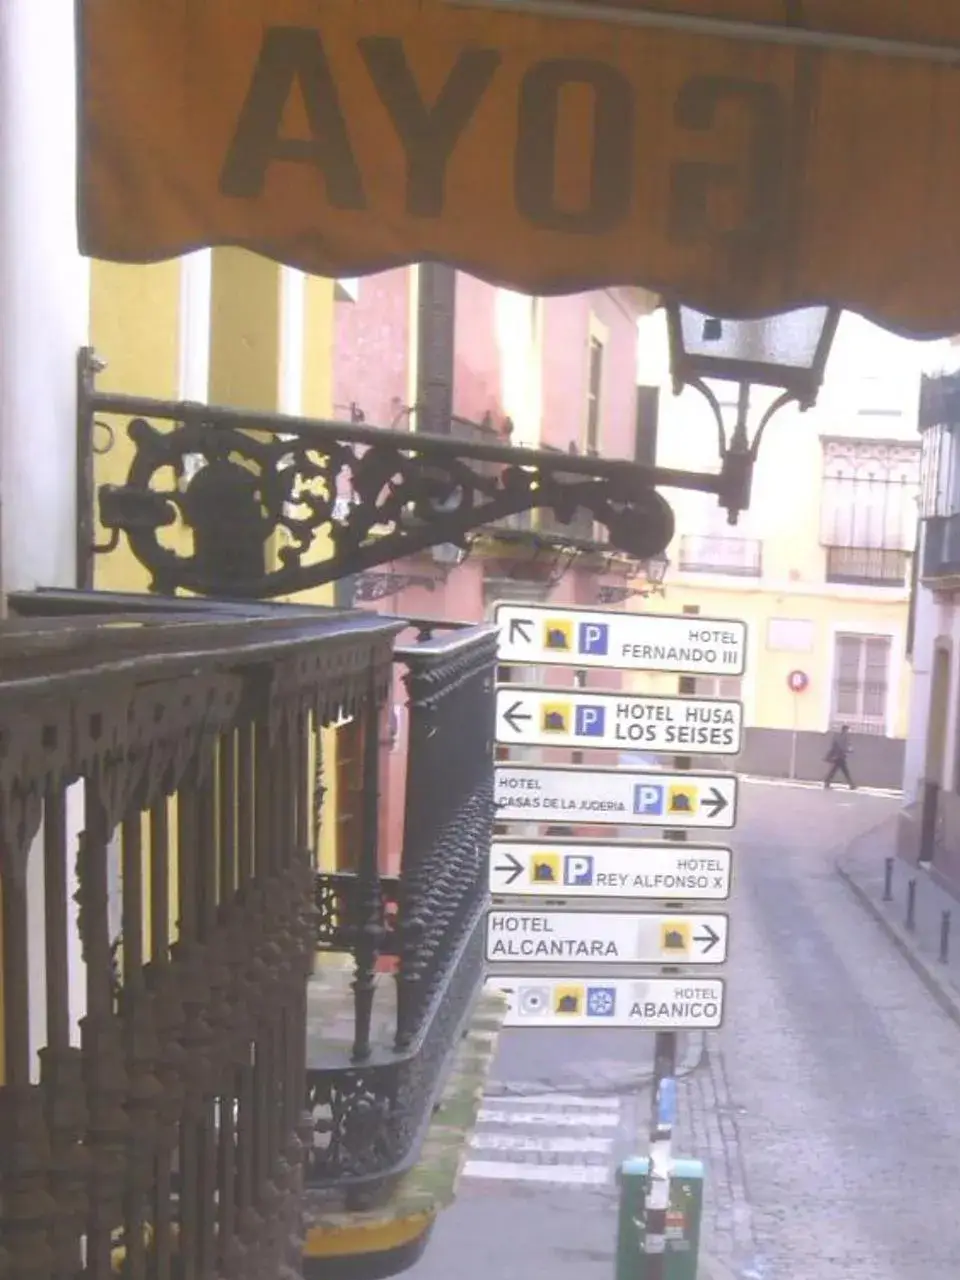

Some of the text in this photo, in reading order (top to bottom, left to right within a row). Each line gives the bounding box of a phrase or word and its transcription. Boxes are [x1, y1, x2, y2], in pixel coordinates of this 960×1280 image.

[688, 630, 738, 644] HOTEL
[622, 644, 738, 664] FERNANDO III
[616, 704, 735, 724] HOTEL HUSA
[615, 723, 734, 745] LOS SEISES
[498, 778, 542, 790] HOTEL
[542, 798, 559, 809] DE
[561, 799, 577, 810] LA
[677, 858, 724, 872] HOTEL
[596, 873, 723, 889] REY ALFONSO X
[492, 917, 553, 932] HOTEL
[492, 939, 619, 956] ALCANTARA
[674, 987, 718, 1000] HOTEL
[629, 1003, 718, 1019] ABANICO
